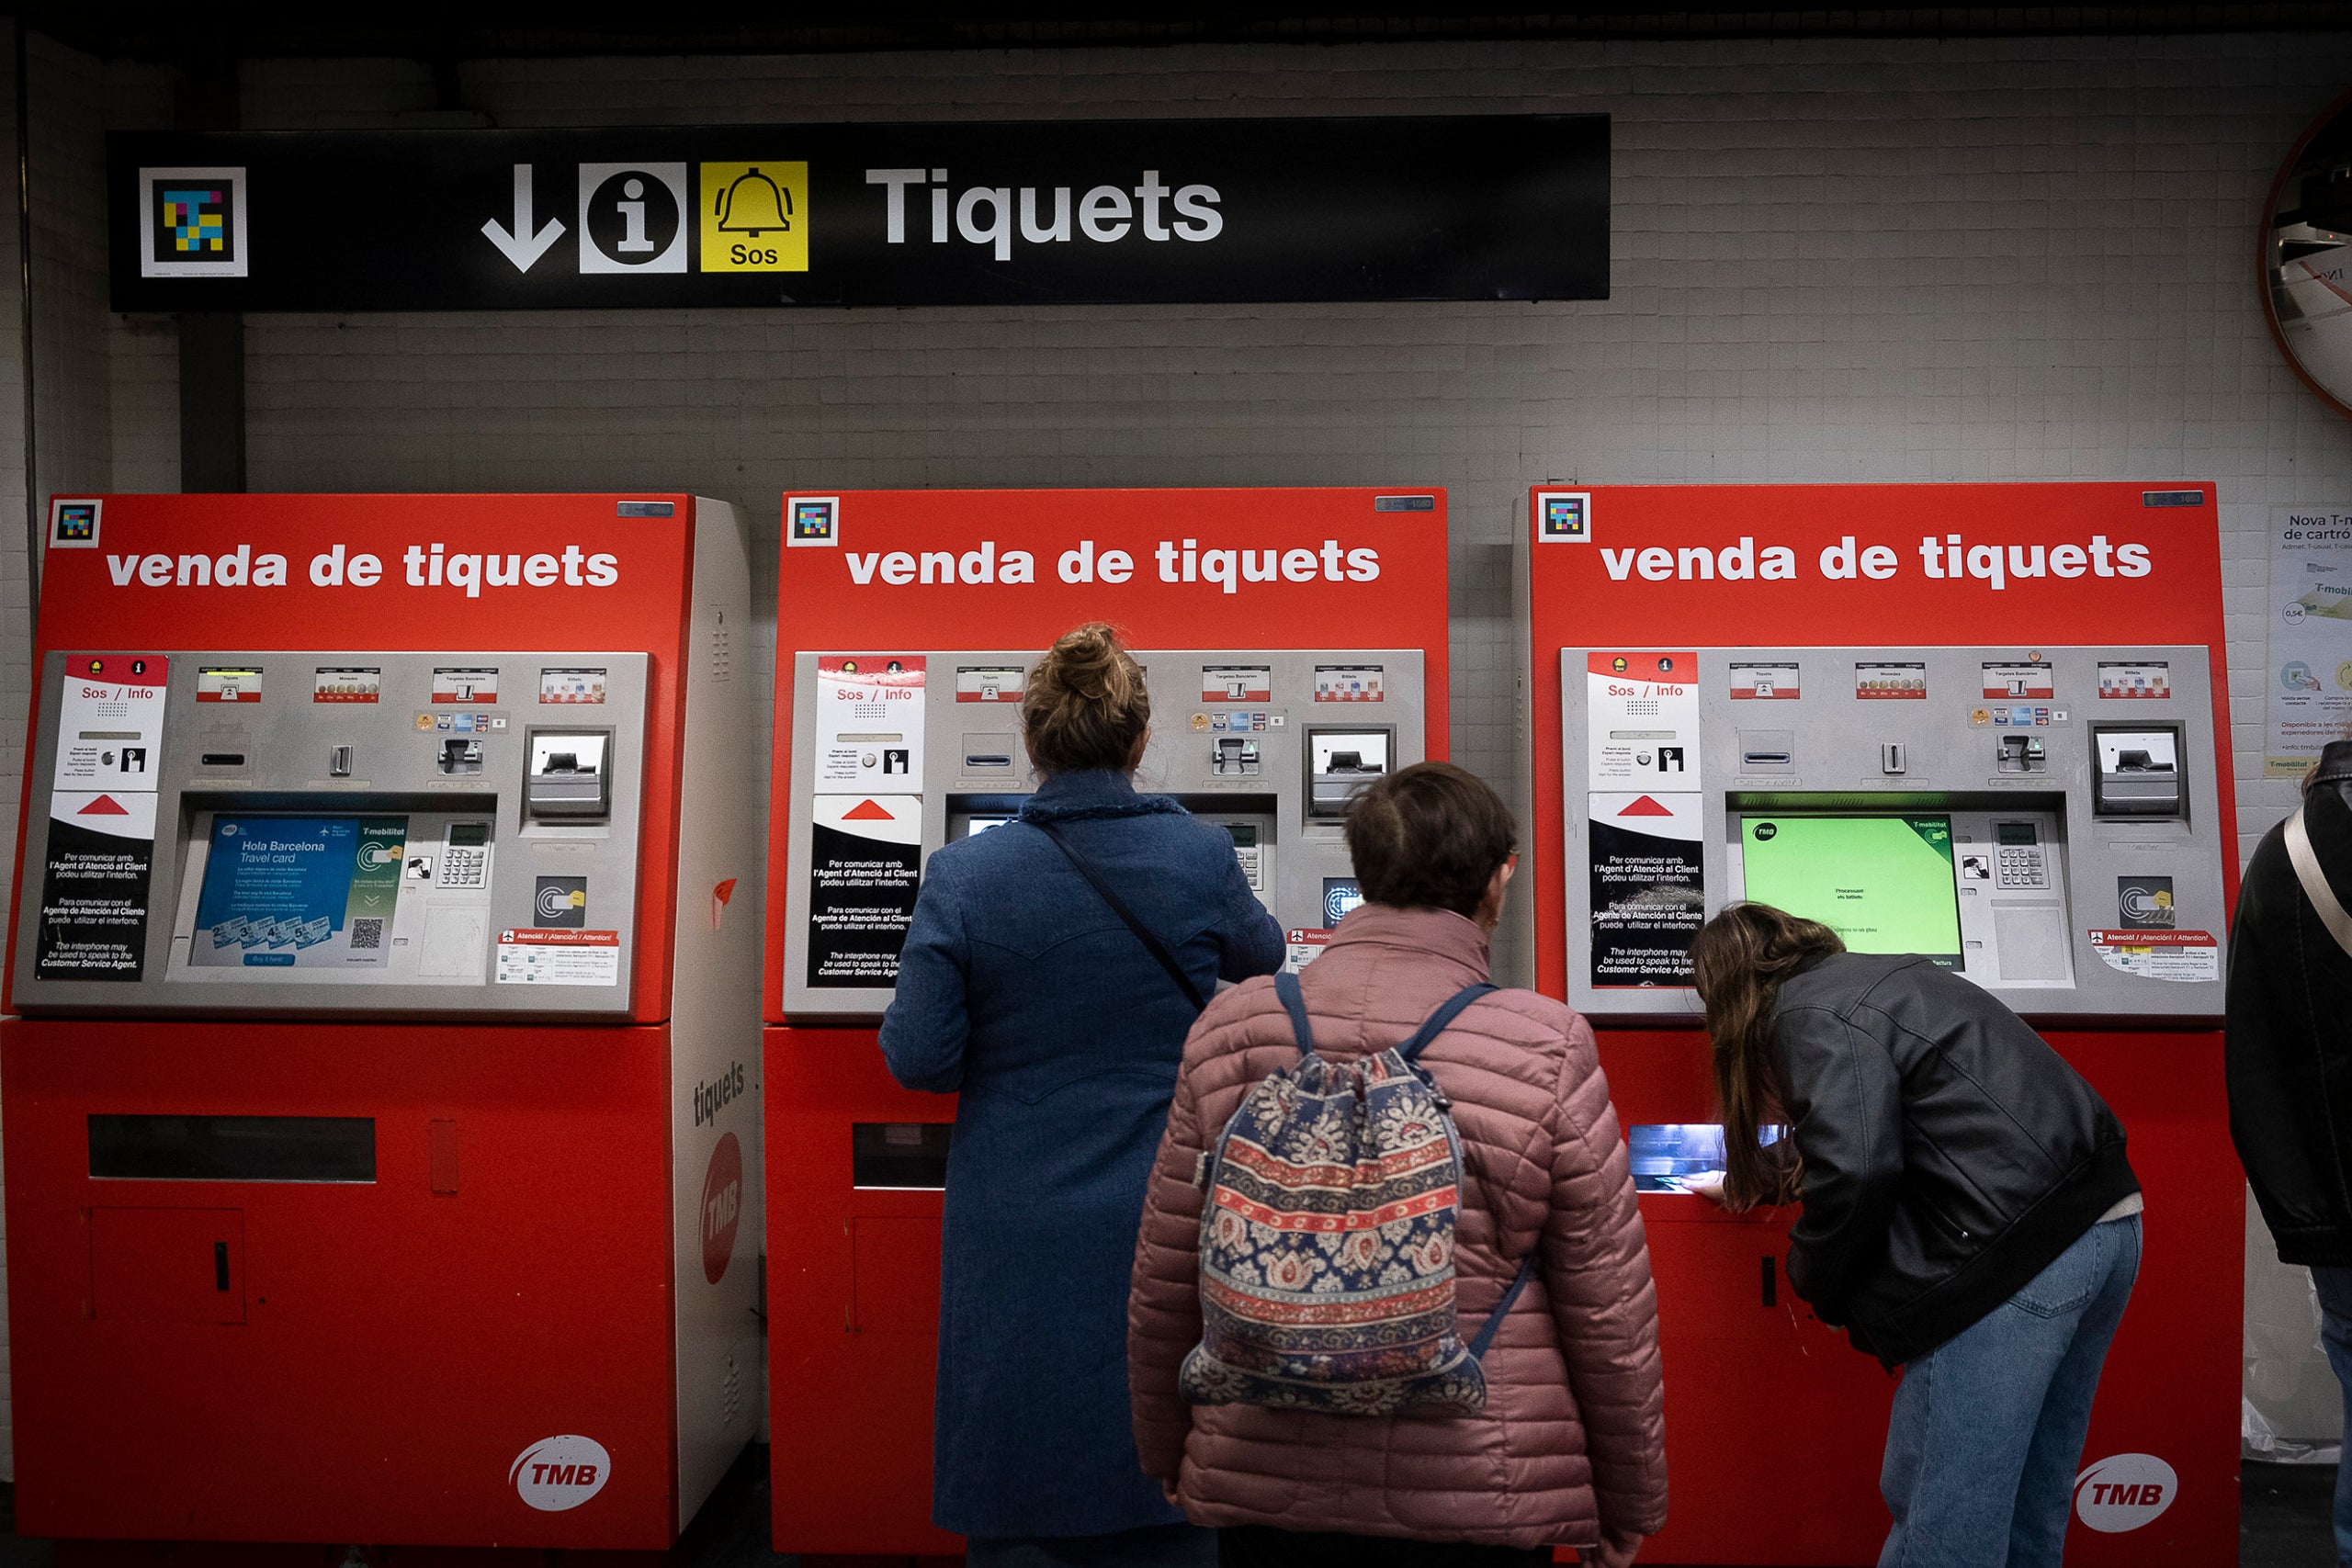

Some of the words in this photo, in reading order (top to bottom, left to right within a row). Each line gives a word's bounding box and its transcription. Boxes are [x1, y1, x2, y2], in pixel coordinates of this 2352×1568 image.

[865, 168, 1224, 261] Tiquets
[729, 243, 778, 266] Sos
[2290, 515, 2326, 526] Nova
[2284, 529, 2302, 540] de
[2307, 528, 2350, 540] cartró
[844, 541, 1035, 585] venda
[1057, 540, 1133, 583] de
[1155, 539, 1381, 594] tiquets
[1600, 536, 1796, 581] venda
[1818, 536, 1898, 580] de
[1918, 534, 2152, 591] tiquets
[107, 545, 288, 587] venda
[309, 545, 383, 587] de
[402, 544, 619, 597] tiquets
[82, 687, 107, 699] Sos
[115, 688, 122, 701] /
[128, 688, 153, 699] Info
[837, 689, 864, 700] Sos
[871, 689, 878, 702] /
[885, 689, 912, 700] Info
[1608, 685, 1634, 696] Sos
[1643, 685, 1649, 698] /
[1657, 685, 1683, 696] Info
[363, 828, 404, 836] T-mobilitat
[242, 840, 266, 852] Hola
[270, 841, 324, 852] Barcelona
[241, 853, 270, 863] Travel
[272, 853, 296, 863] card
[829, 860, 842, 868] Per
[885, 860, 903, 868] amb
[813, 869, 842, 879] l'Agent
[843, 869, 883, 877] d'Atenció
[884, 869, 892, 877] al
[894, 869, 918, 877] Client
[1595, 865, 1623, 874] l'Agent
[820, 879, 844, 887] podeu
[1602, 874, 1626, 883] podeu
[1609, 902, 1626, 910] Para
[812, 914, 837, 922] Agente
[849, 914, 881, 922] Atención
[1593, 911, 1620, 920] Agente
[1622, 911, 1631, 919] de
[1633, 911, 1666, 919] Atención
[1600, 921, 1623, 930] puede
[1662, 921, 1698, 930] interfono.
[212, 928, 220, 937] 2
[240, 928, 247, 937] 3
[267, 928, 275, 937] 4
[295, 927, 303, 937] 5
[844, 953, 880, 961] interphone
[881, 953, 897, 961] may
[1627, 948, 1668, 957] interphone
[1669, 949, 1688, 957] may
[41, 959, 80, 967] Customer
[81, 959, 110, 968] Service
[111, 960, 138, 970] Agent.
[860, 961, 881, 969] speak
[1645, 956, 1669, 965] speak
[883, 968, 898, 977] Age
[1597, 965, 1638, 974] Customer
[1639, 965, 1671, 974] Service
[1673, 966, 1695, 976] Agen
[694, 1061, 744, 1128] tiquets
[708, 1179, 738, 1241] TMB
[531, 1463, 597, 1485] TMB
[2092, 1483, 2164, 1506] TMB
